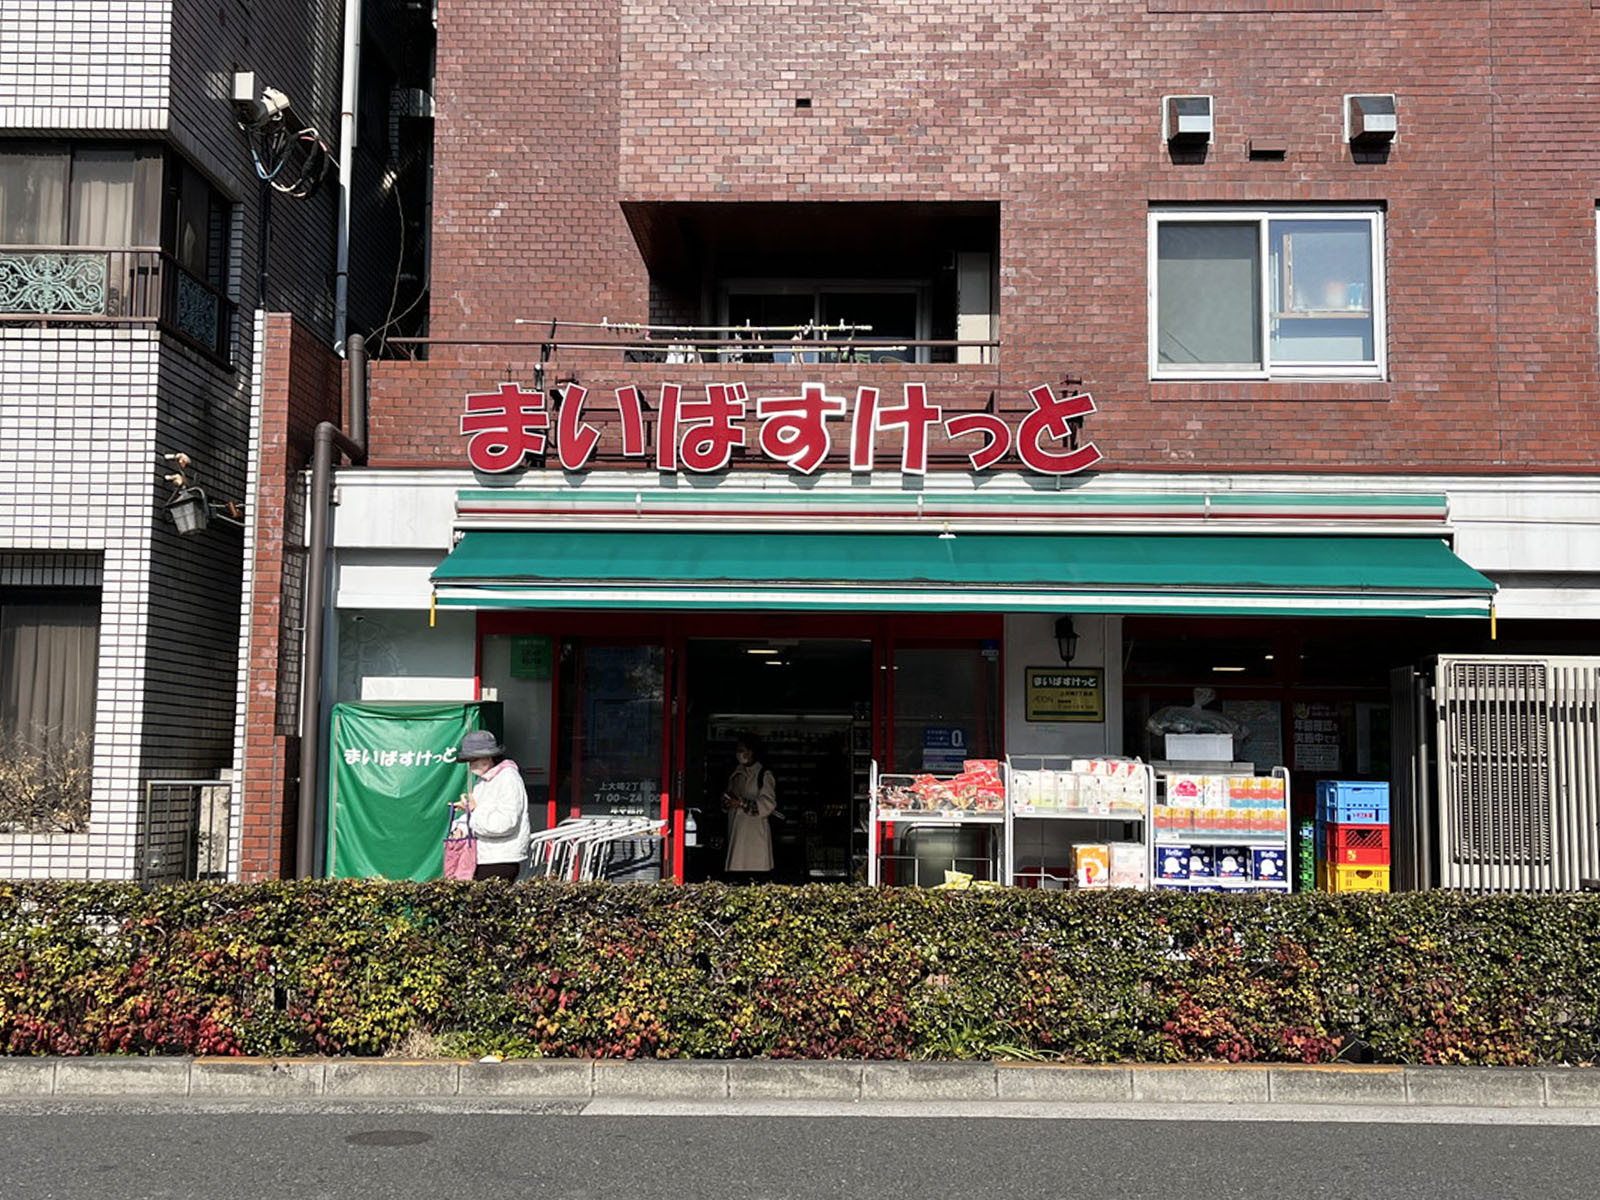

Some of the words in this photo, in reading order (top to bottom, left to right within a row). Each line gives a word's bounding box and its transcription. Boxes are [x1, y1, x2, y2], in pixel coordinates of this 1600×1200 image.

[459, 381, 1103, 476] まいばすけっと
[1033, 676, 1097, 688] まいばすけっと
[343, 746, 457, 767] まいばすけっと
